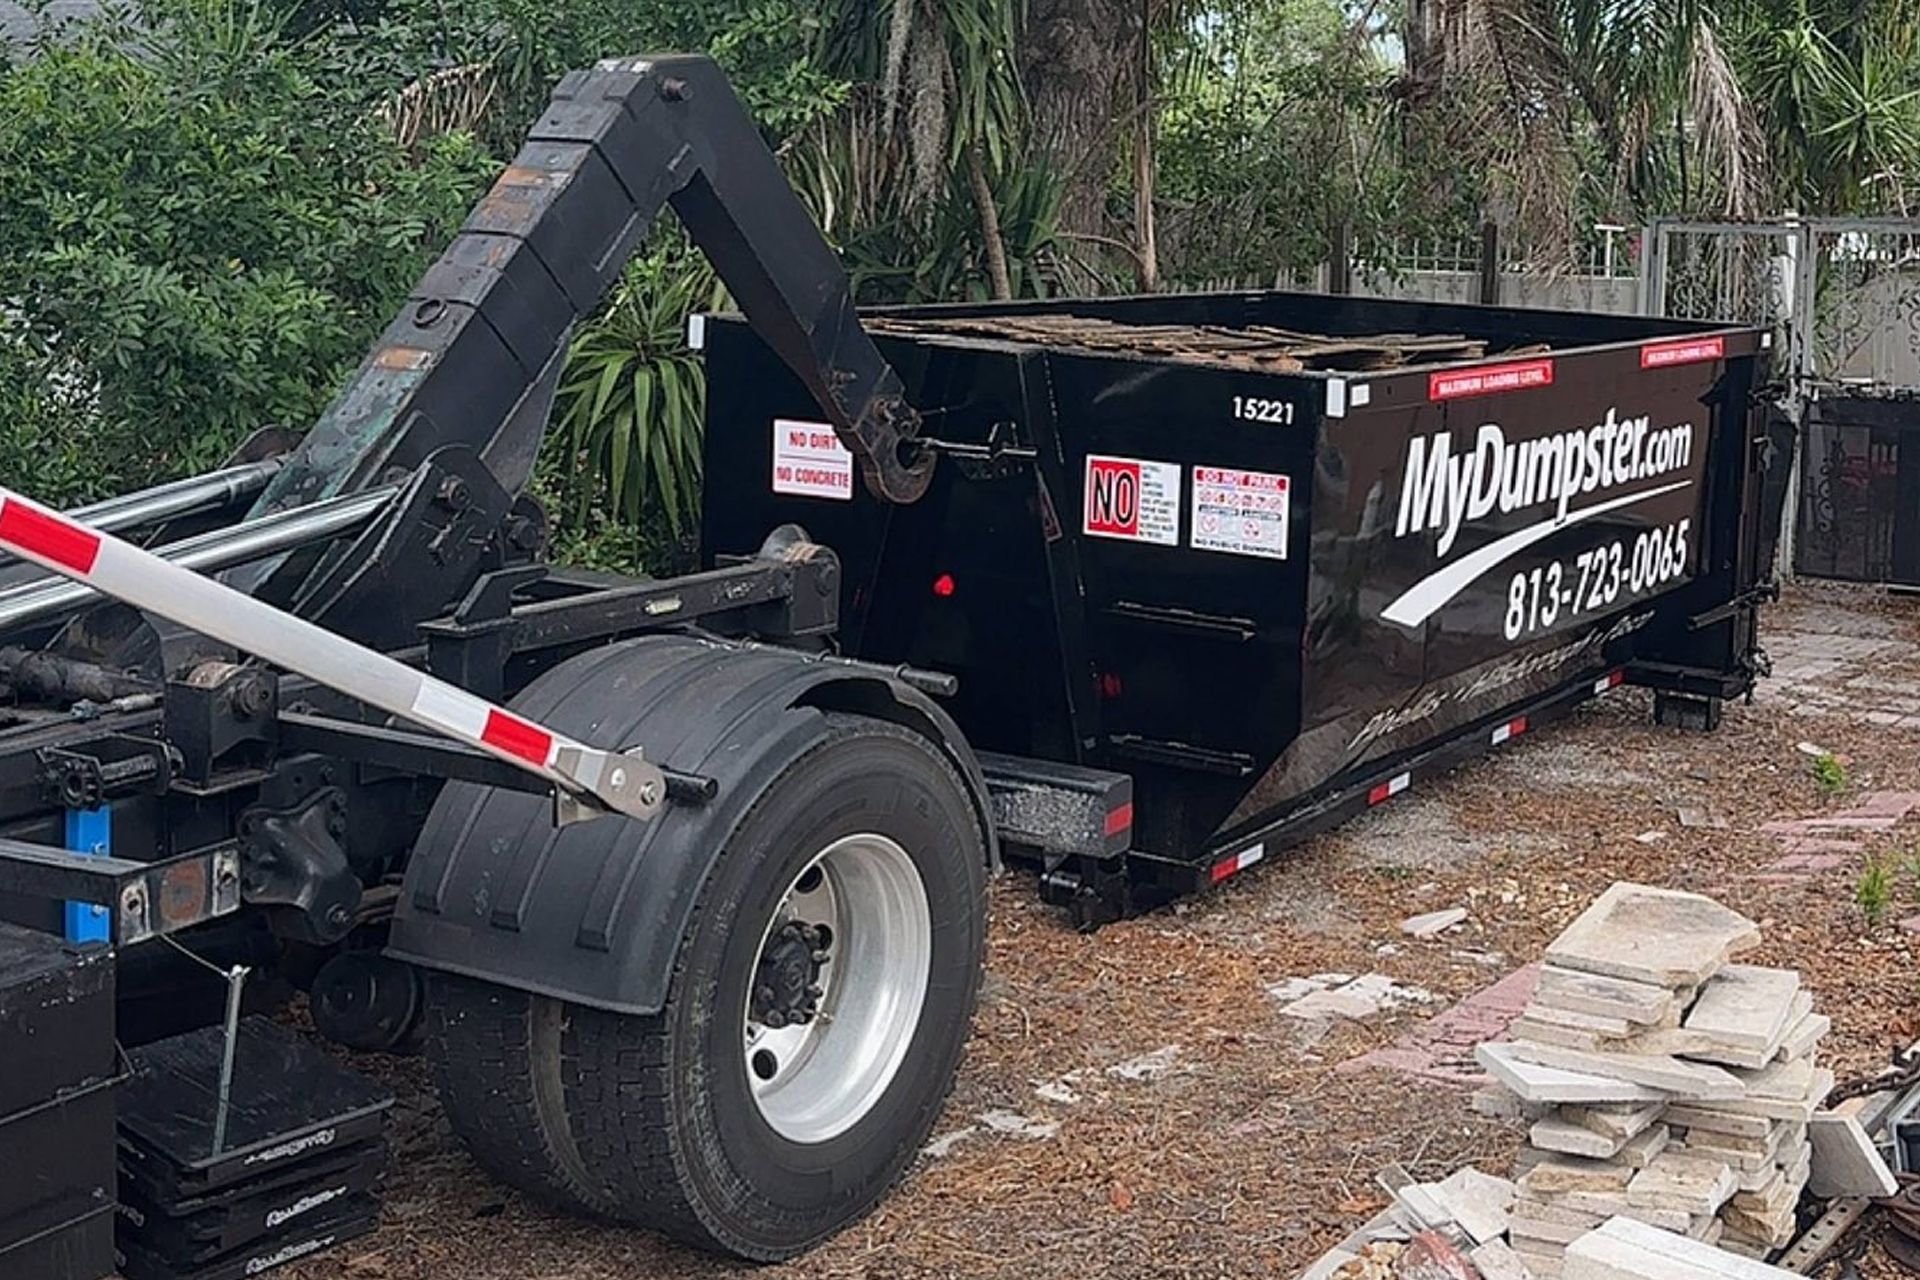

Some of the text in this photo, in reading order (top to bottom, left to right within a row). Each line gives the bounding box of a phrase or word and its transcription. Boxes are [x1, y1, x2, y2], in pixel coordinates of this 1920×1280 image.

[1483, 372, 1519, 389] LOADING
[1233, 396, 1294, 425] 15221
[790, 432, 837, 450] NO DIRT
[777, 466, 849, 489] NO CONCRETE
[1395, 407, 1692, 558] MyDumpster.com
[1091, 467, 1136, 528] NO
[1210, 540, 1241, 551] PUBLIC
[1242, 544, 1283, 556] DUMPING
[1505, 519, 1690, 640] 813-723-0065
